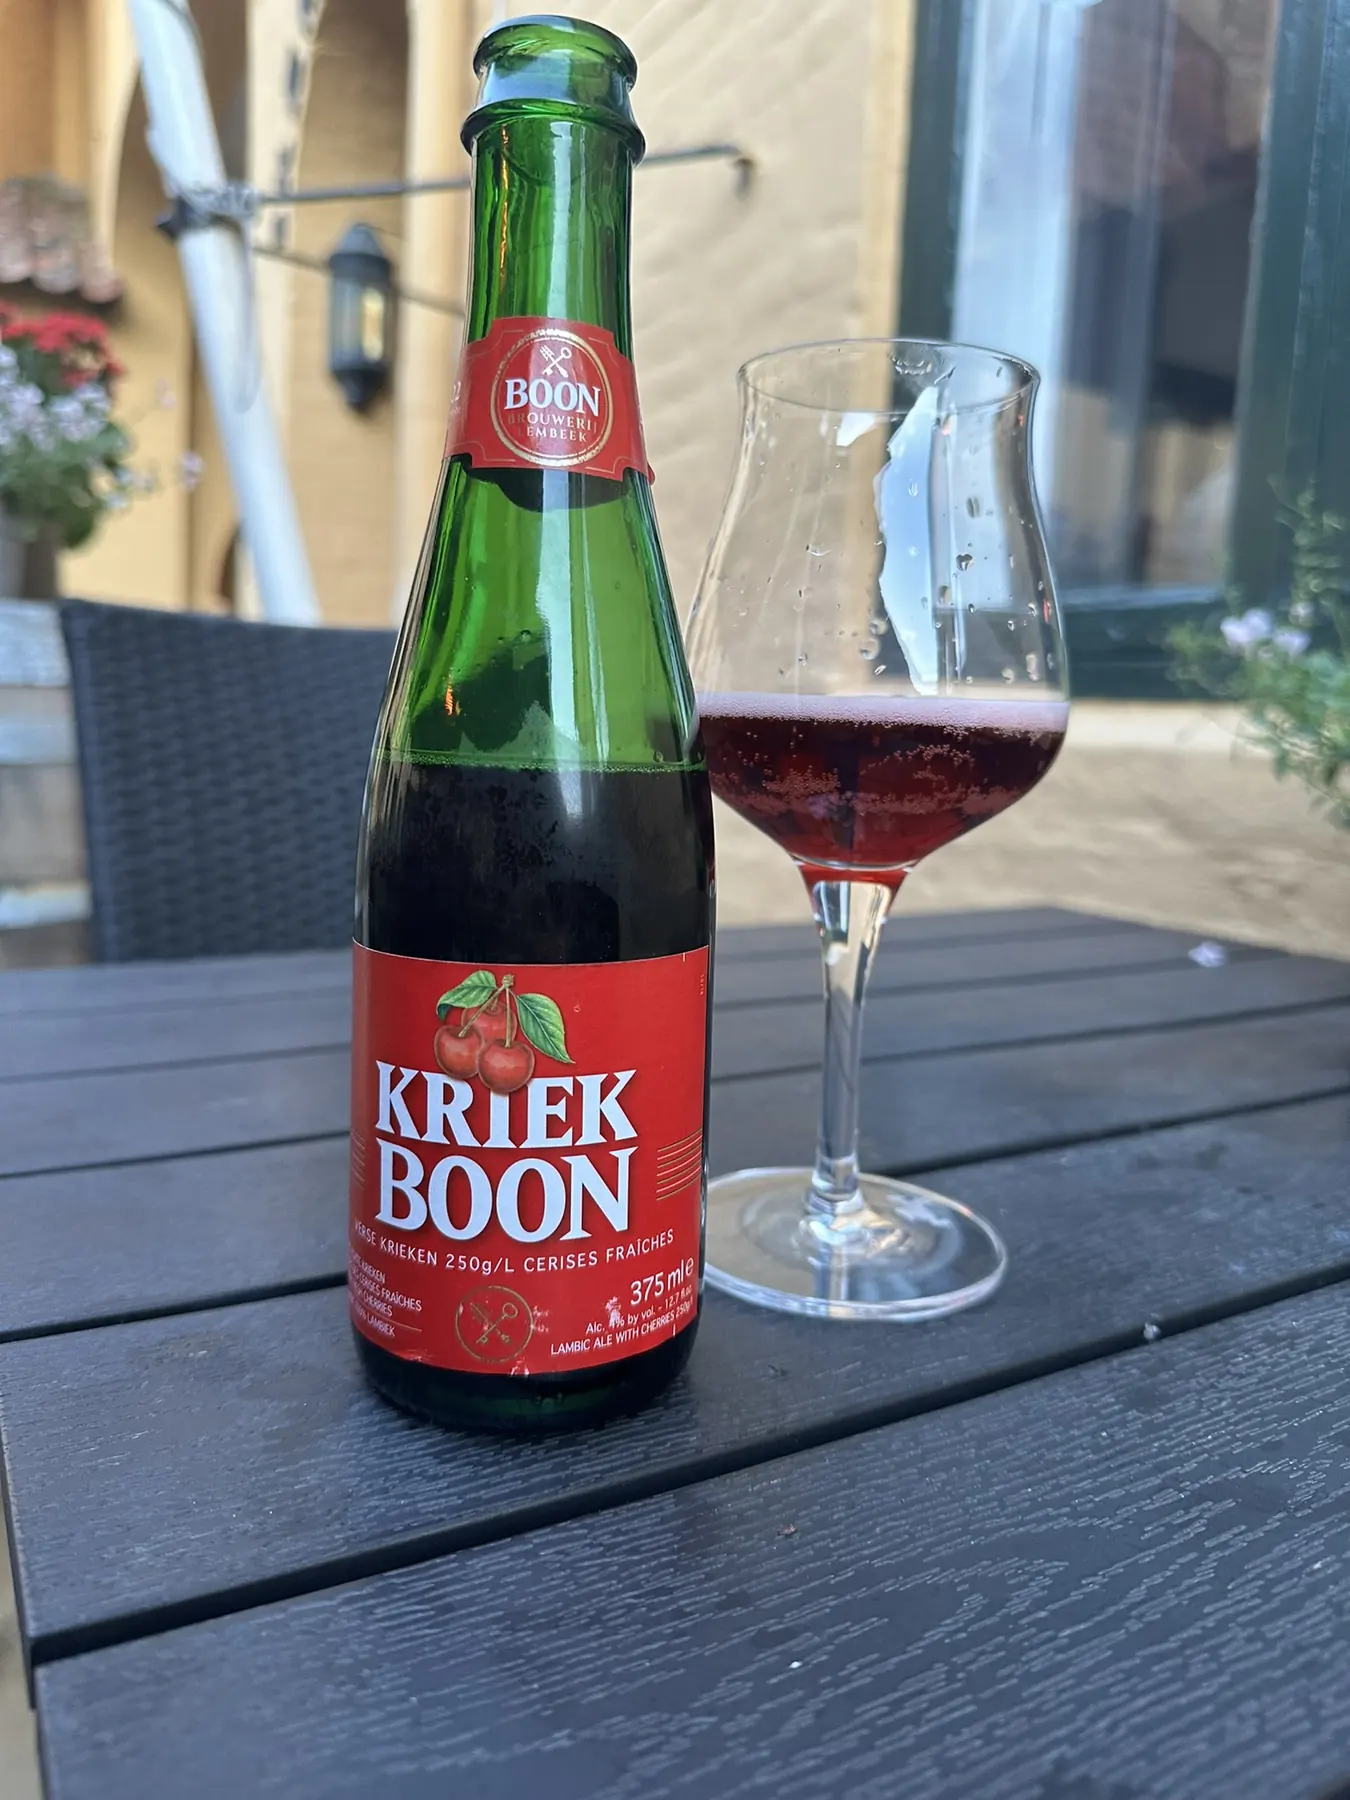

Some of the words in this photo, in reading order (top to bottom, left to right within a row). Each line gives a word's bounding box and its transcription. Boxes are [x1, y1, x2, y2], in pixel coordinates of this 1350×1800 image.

[504, 379, 601, 417] BOON
[375, 1060, 638, 1149] KRIEK
[375, 1137, 638, 1243] BOON
[380, 1236, 438, 1266] KRIEKEN
[446, 1253, 515, 1275] 250g/L
[524, 1251, 598, 1273] CERISES
[606, 1228, 674, 1263] FRAÎCHES
[550, 1338, 591, 1356] LAMBIC
[594, 1333, 613, 1349] ALE
[616, 1326, 639, 1344] WITH
[641, 1309, 675, 1335] CHERRIES
[628, 1313, 639, 1326] by
